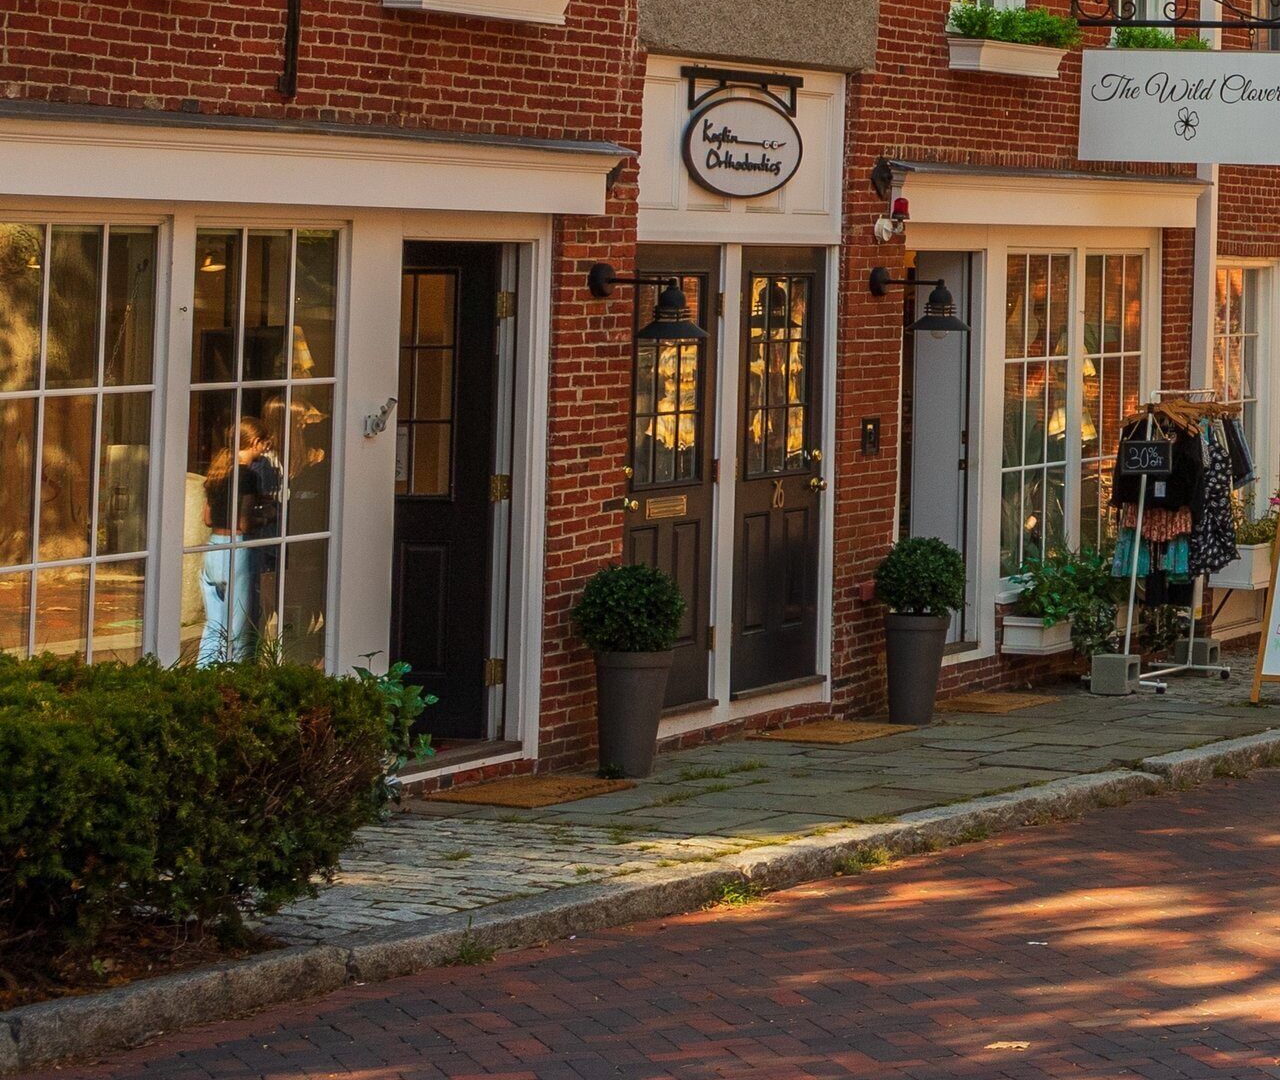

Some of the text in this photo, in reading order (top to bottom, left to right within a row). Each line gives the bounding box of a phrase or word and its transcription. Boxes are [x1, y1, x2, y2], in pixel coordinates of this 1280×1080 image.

[1091, 73, 1140, 102] The
[1144, 71, 1217, 104] Wild
[706, 148, 782, 176] Orthodontics
